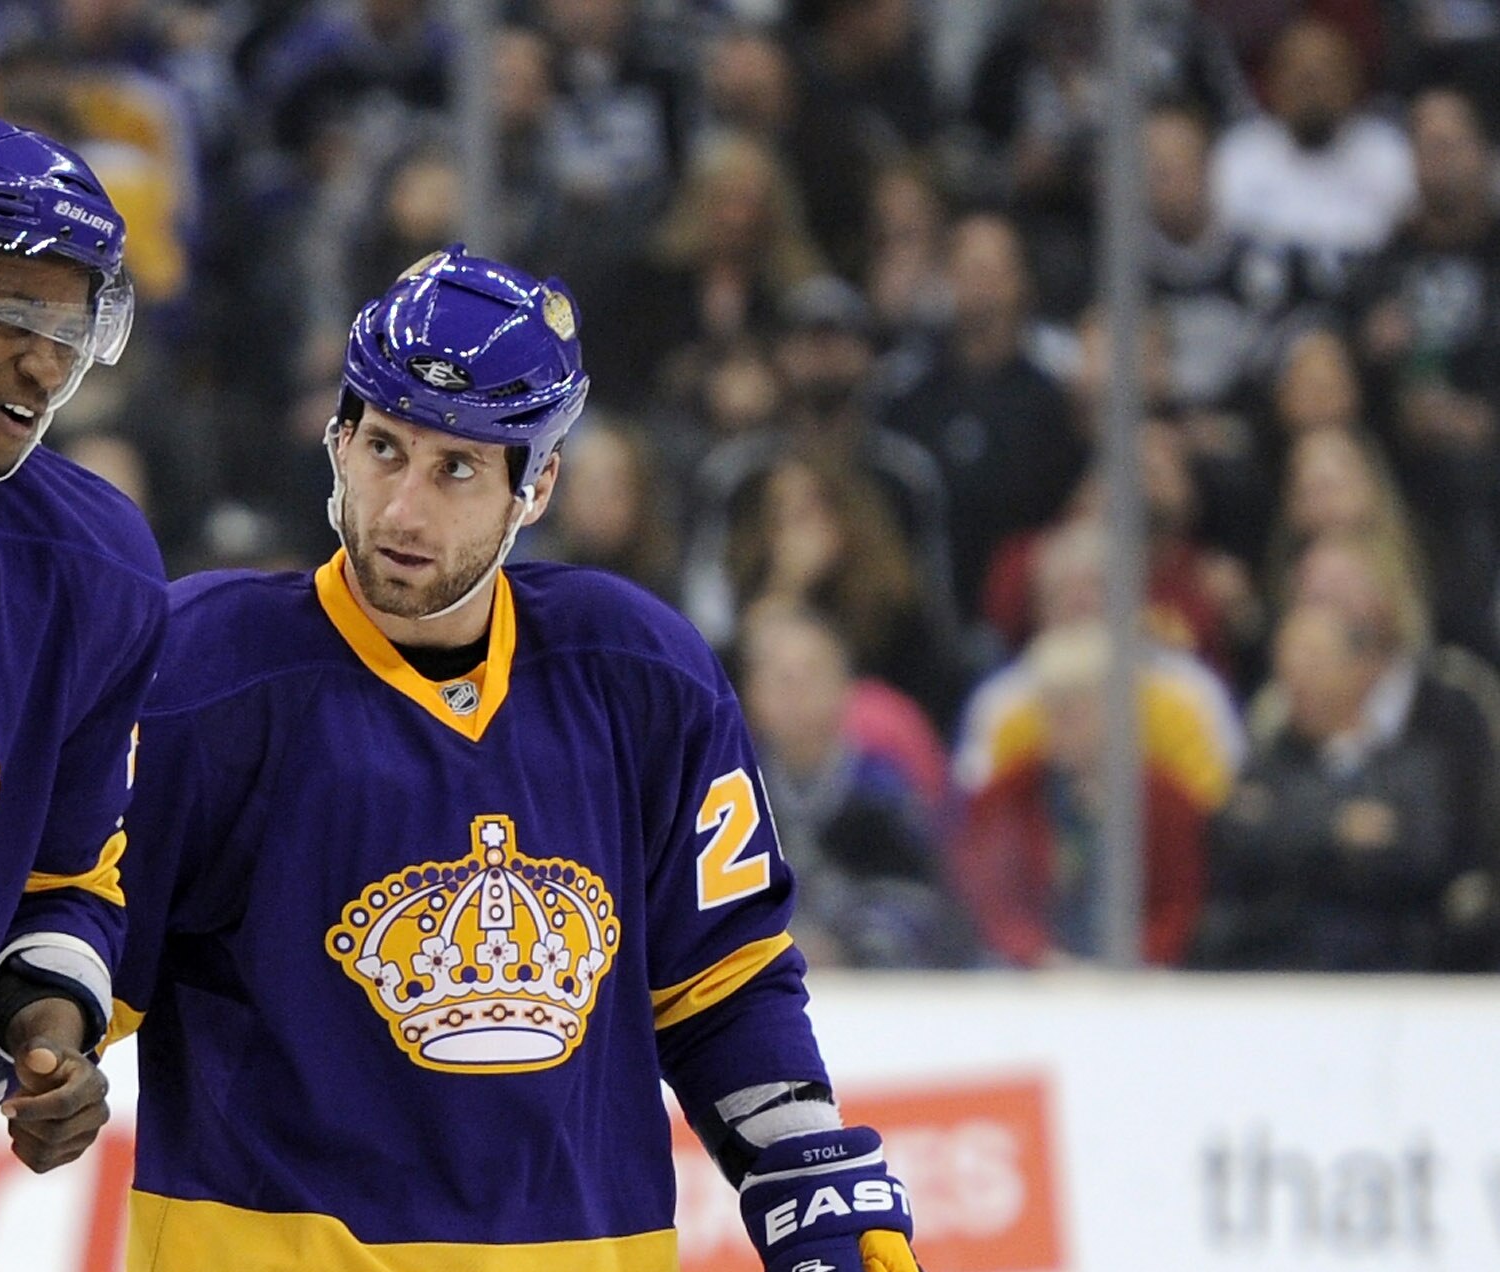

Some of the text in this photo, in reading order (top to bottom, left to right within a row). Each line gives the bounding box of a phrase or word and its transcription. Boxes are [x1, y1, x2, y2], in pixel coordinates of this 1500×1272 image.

[695, 767, 785, 911] 2
[802, 1144, 848, 1162] STOLL
[1198, 1120, 1442, 1254] that
